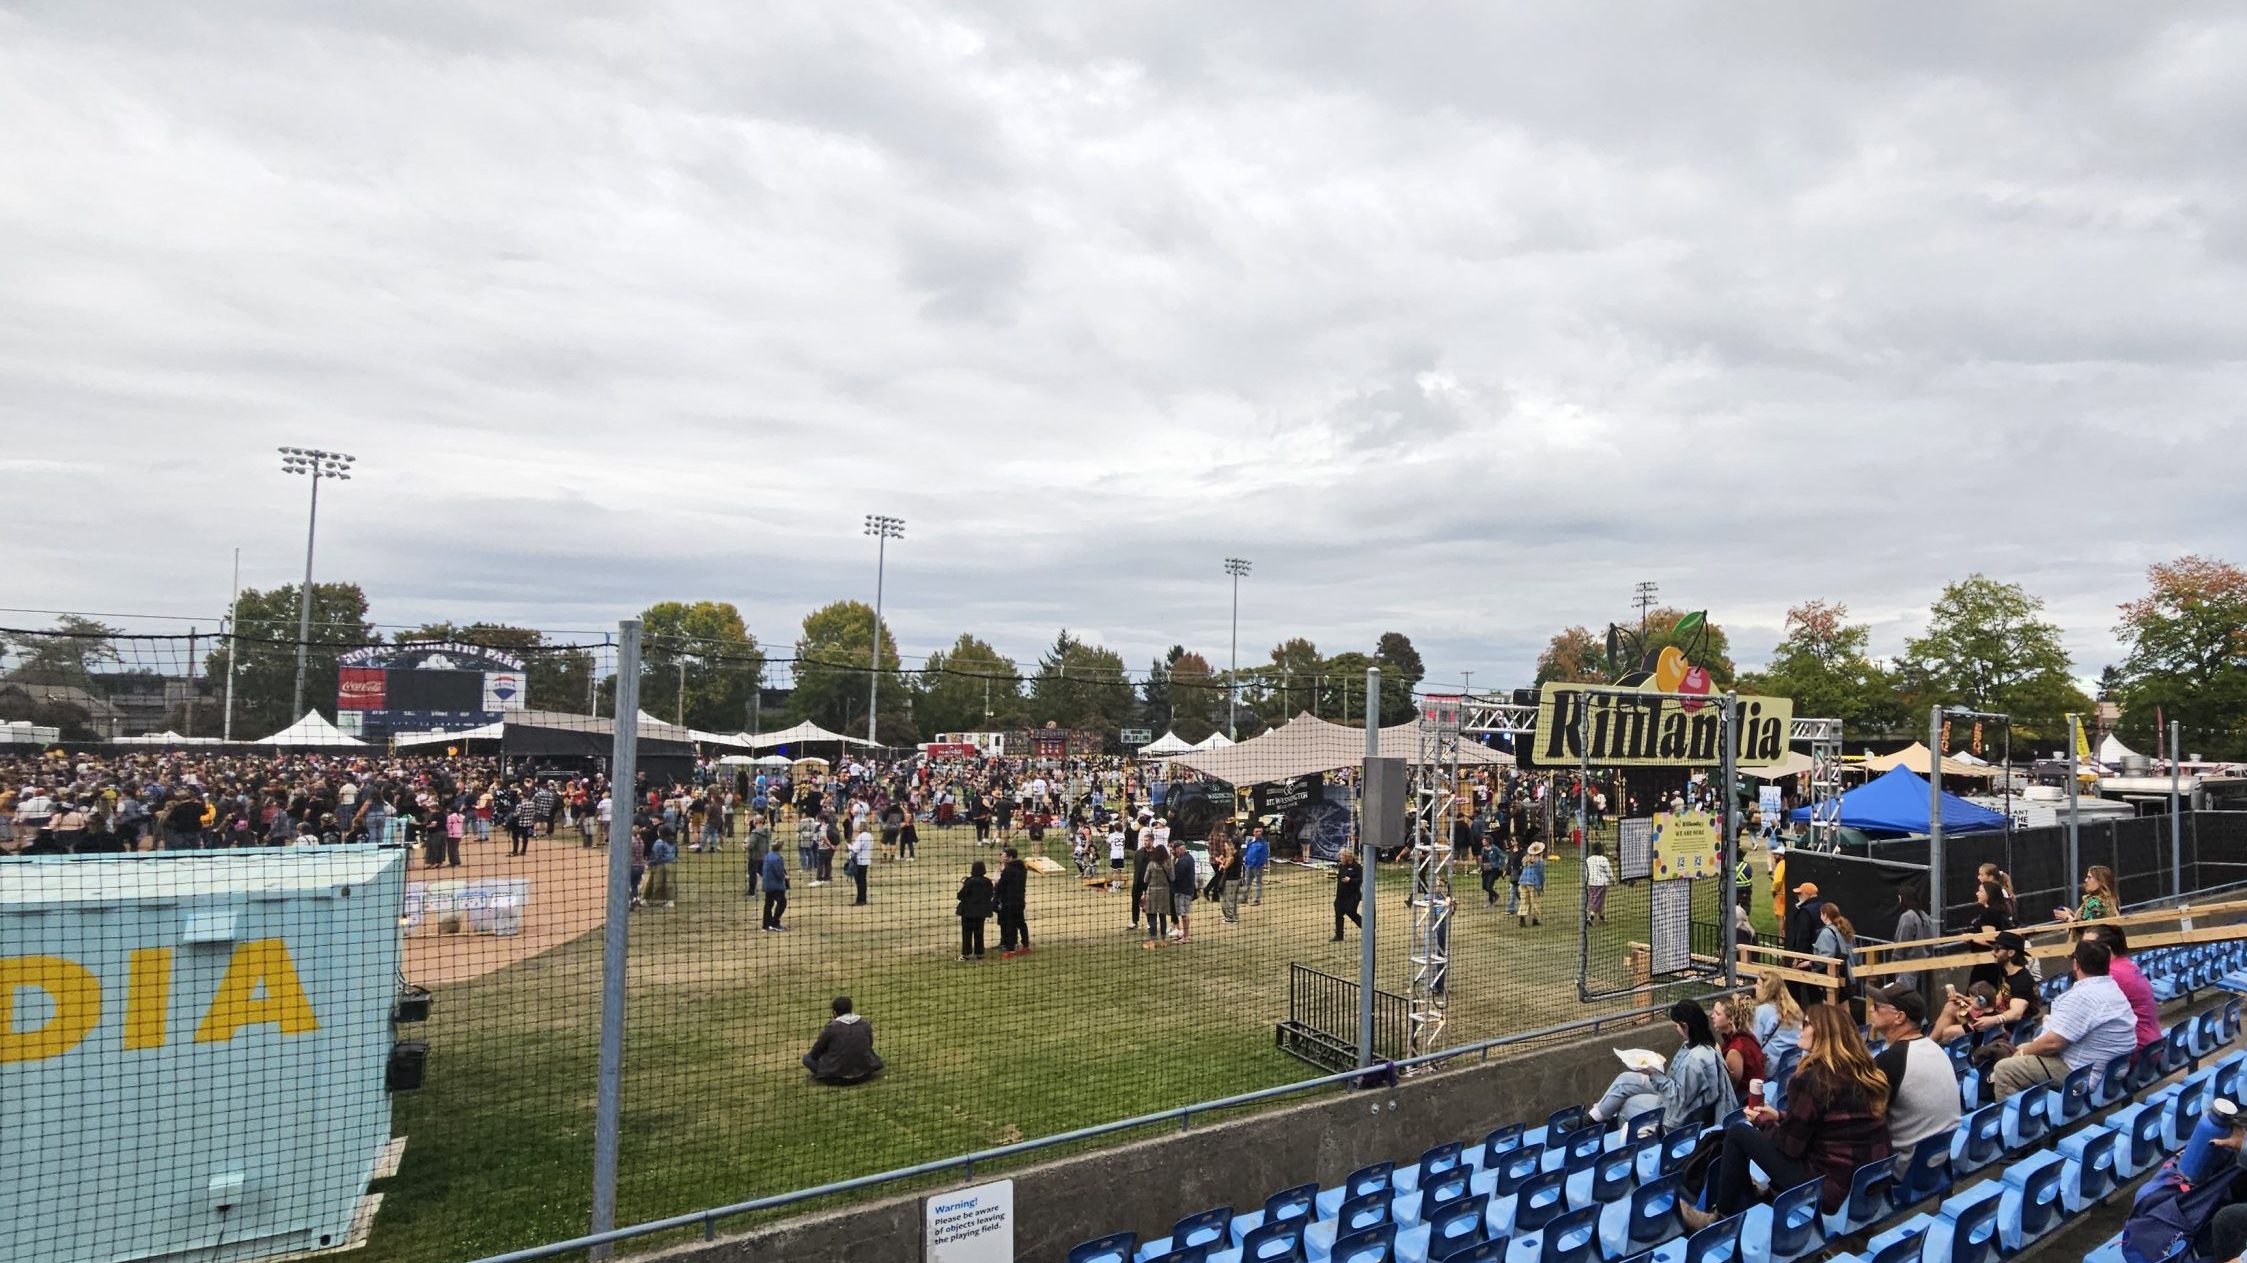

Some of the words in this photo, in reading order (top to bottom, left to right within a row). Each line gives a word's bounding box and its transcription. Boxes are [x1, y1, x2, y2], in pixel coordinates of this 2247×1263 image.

[343, 646, 397, 664] ROYAL
[403, 640, 480, 655] ATHLETIC
[484, 648, 526, 670] PARK
[1114, 837, 1124, 846] 23
[935, 1197, 978, 1214] Warning!
[935, 1213, 962, 1226] Please
[963, 1210, 974, 1219] be
[975, 1205, 999, 1217] aware
[934, 1226, 944, 1236] of
[945, 1219, 975, 1233] objects
[977, 1212, 1006, 1224] leaving
[934, 1235, 949, 1245] the
[950, 1228, 980, 1243] playing
[981, 1223, 1001, 1233] field.
